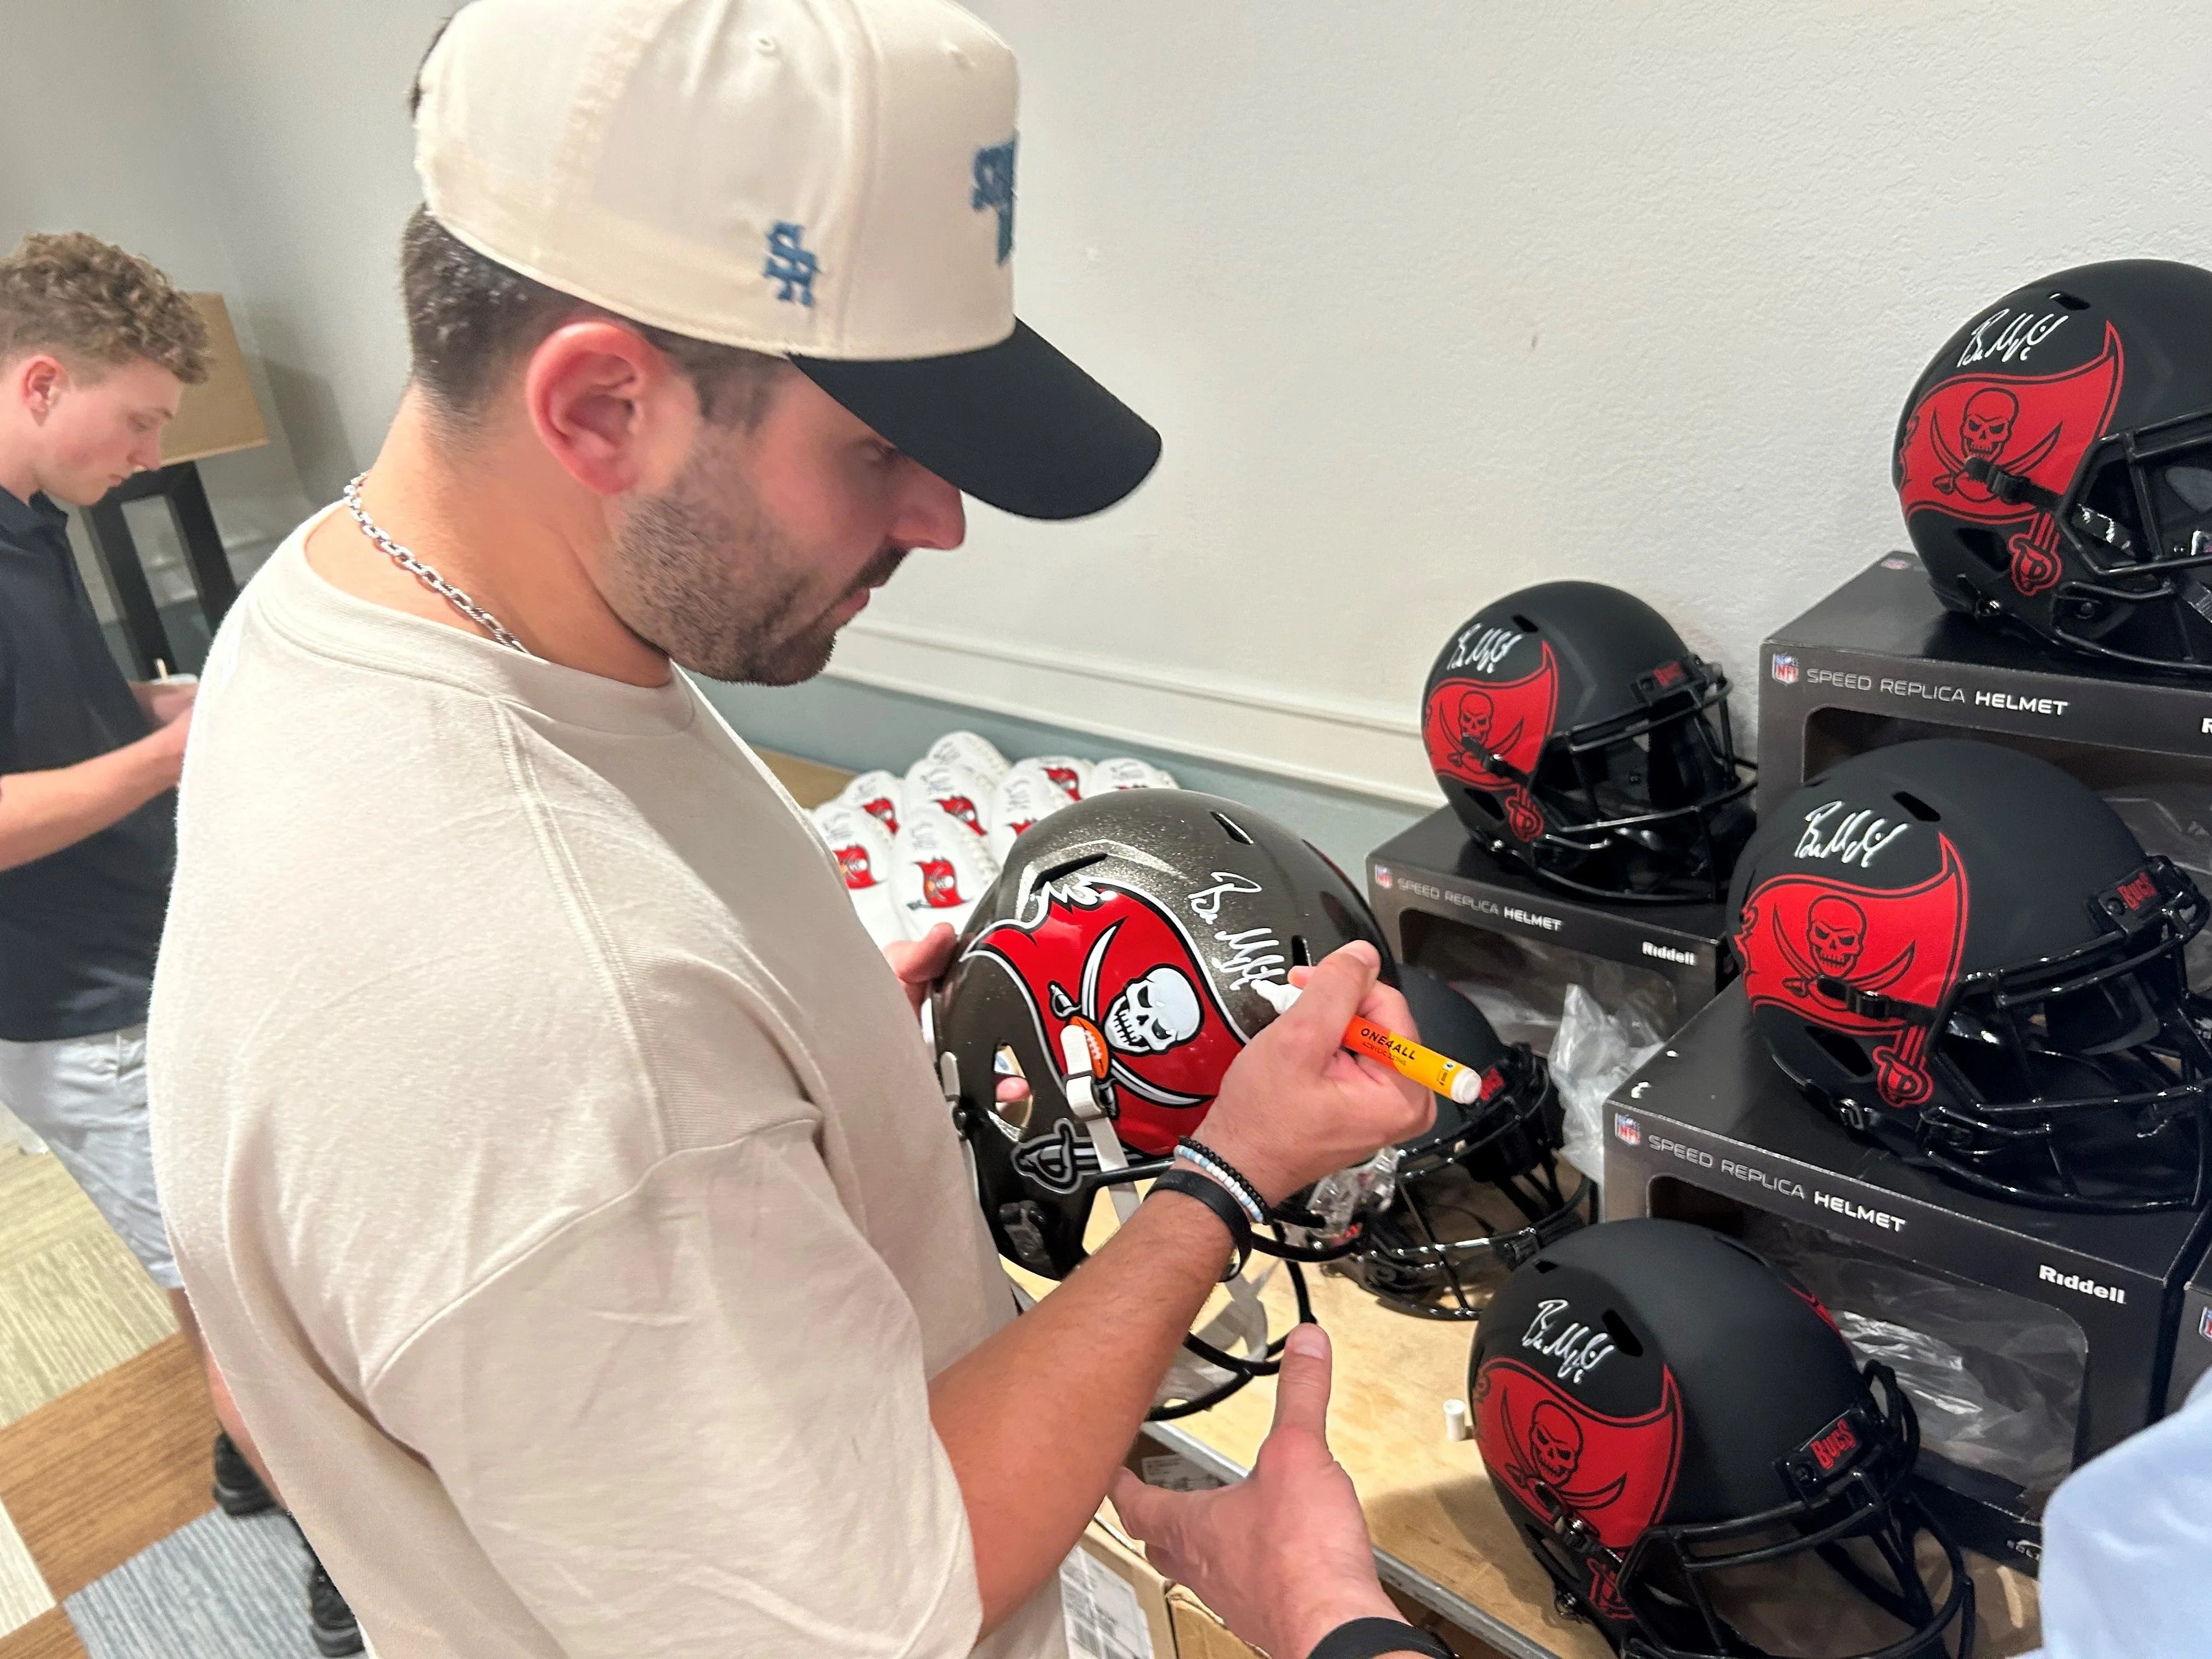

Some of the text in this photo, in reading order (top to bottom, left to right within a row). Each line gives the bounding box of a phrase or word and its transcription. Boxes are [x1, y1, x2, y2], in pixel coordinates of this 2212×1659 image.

[1806, 668, 2069, 715] SPEED REPLICA HELMET
[1397, 877, 1563, 932] SPEED REPLICA HELMET
[1642, 941, 1696, 966] Riddell
[1361, 1028, 1415, 1060] ONE4ALL
[1648, 1134, 1907, 1233] SPEED REPLICA HELMET
[2039, 1263, 2126, 1305] Riddell
